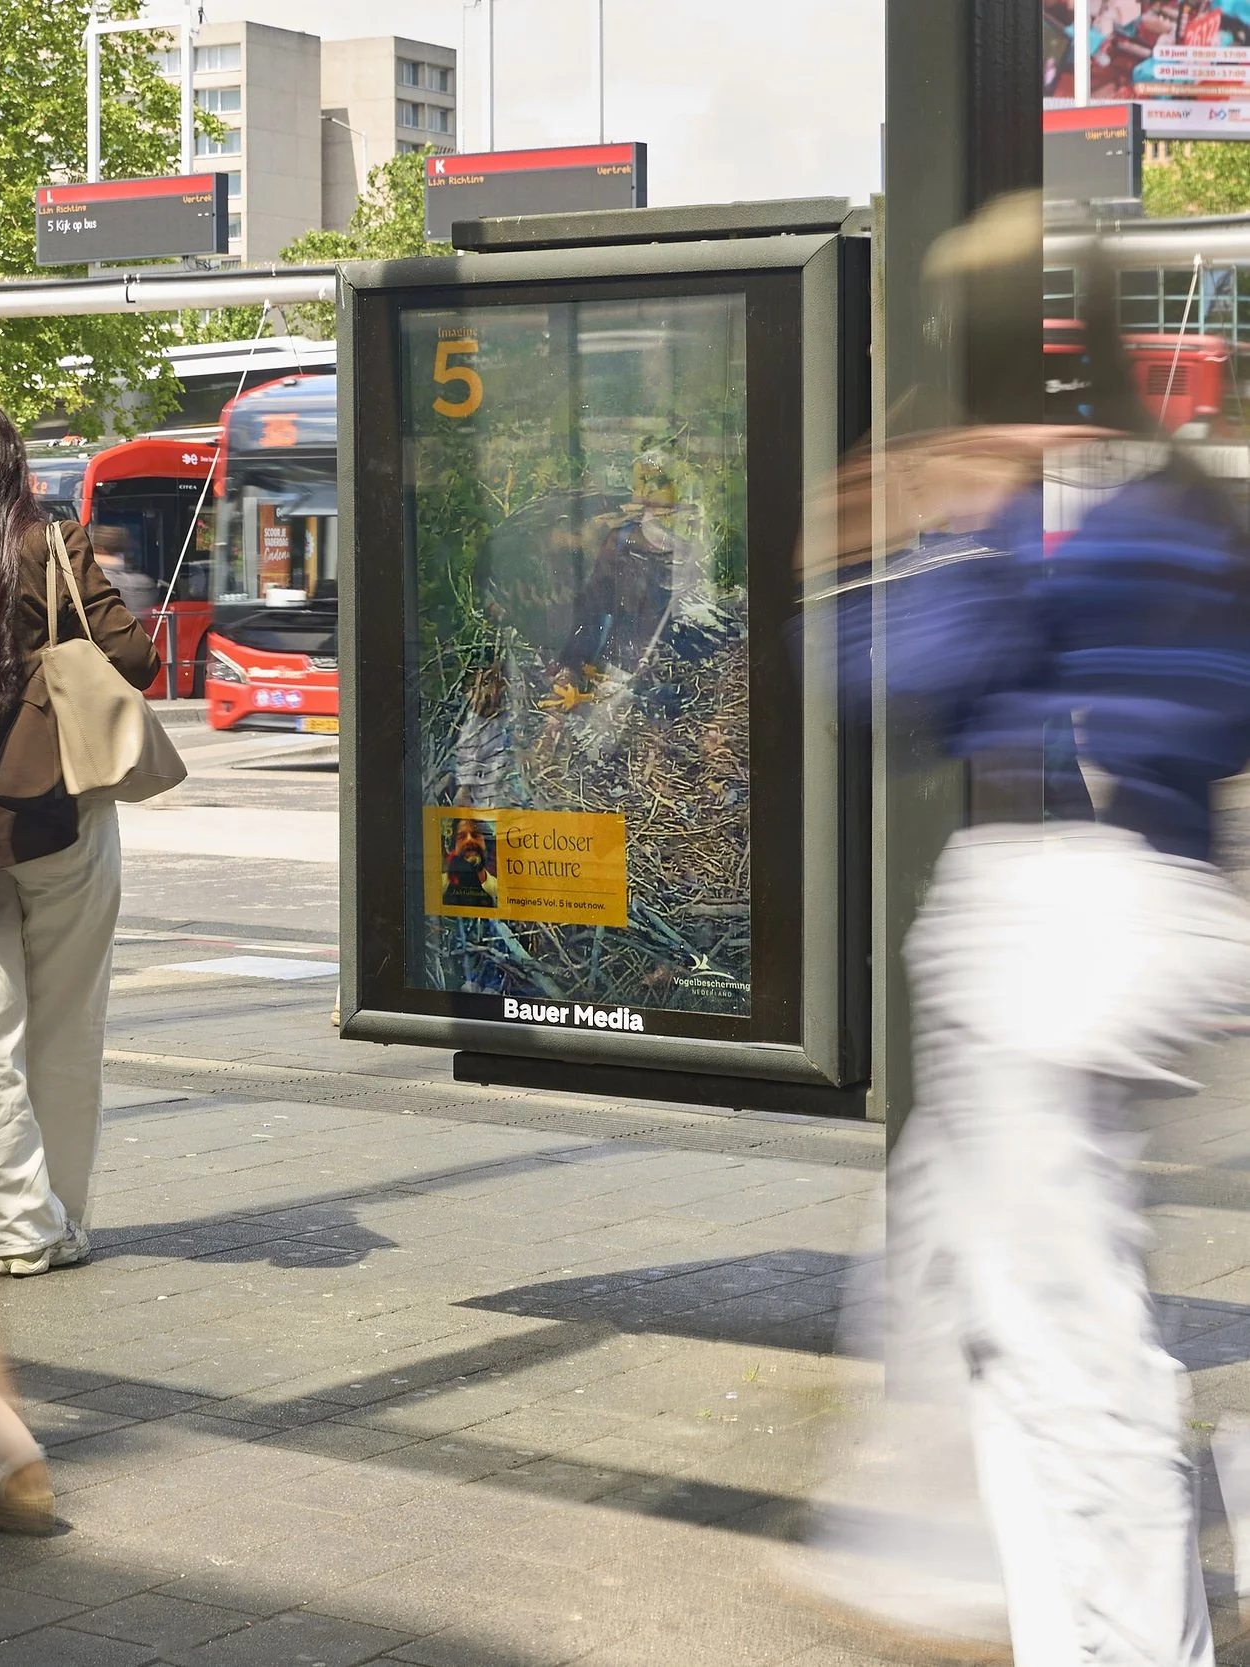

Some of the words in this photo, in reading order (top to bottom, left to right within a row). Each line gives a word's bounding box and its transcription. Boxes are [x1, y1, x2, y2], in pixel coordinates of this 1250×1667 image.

[1171, 50, 1188, 58] juni
[1171, 68, 1188, 76] juni
[435, 159, 445, 174] K
[428, 177, 445, 187] Lijn
[448, 175, 485, 185] Richting
[597, 165, 632, 176] Vertrek
[46, 190, 53, 203] L
[39, 206, 53, 215] Lijn
[56, 204, 87, 214] Richting
[182, 194, 213, 204] Vertrek
[47, 220, 54, 232] 5
[56, 219, 70, 234] Kijk
[73, 221, 82, 233] op
[84, 218, 97, 230] bus
[125, 286, 136, 304] L
[438, 327, 479, 339] Imagine
[433, 340, 484, 418] 5
[506, 827, 539, 850] Get
[543, 829, 593, 852] closer
[506, 857, 524, 875] to
[528, 859, 581, 877] nature
[507, 896, 542, 908] Imagine5
[544, 899, 558, 907] Vol.
[559, 899, 565, 908] 5
[565, 899, 572, 908] is
[573, 901, 586, 909] out
[587, 902, 606, 910] now.
[673, 977, 750, 992] Vogelbescherming
[691, 988, 733, 998] NEDERLAND
[503, 997, 569, 1024] Bauer
[573, 1004, 644, 1032] Media
